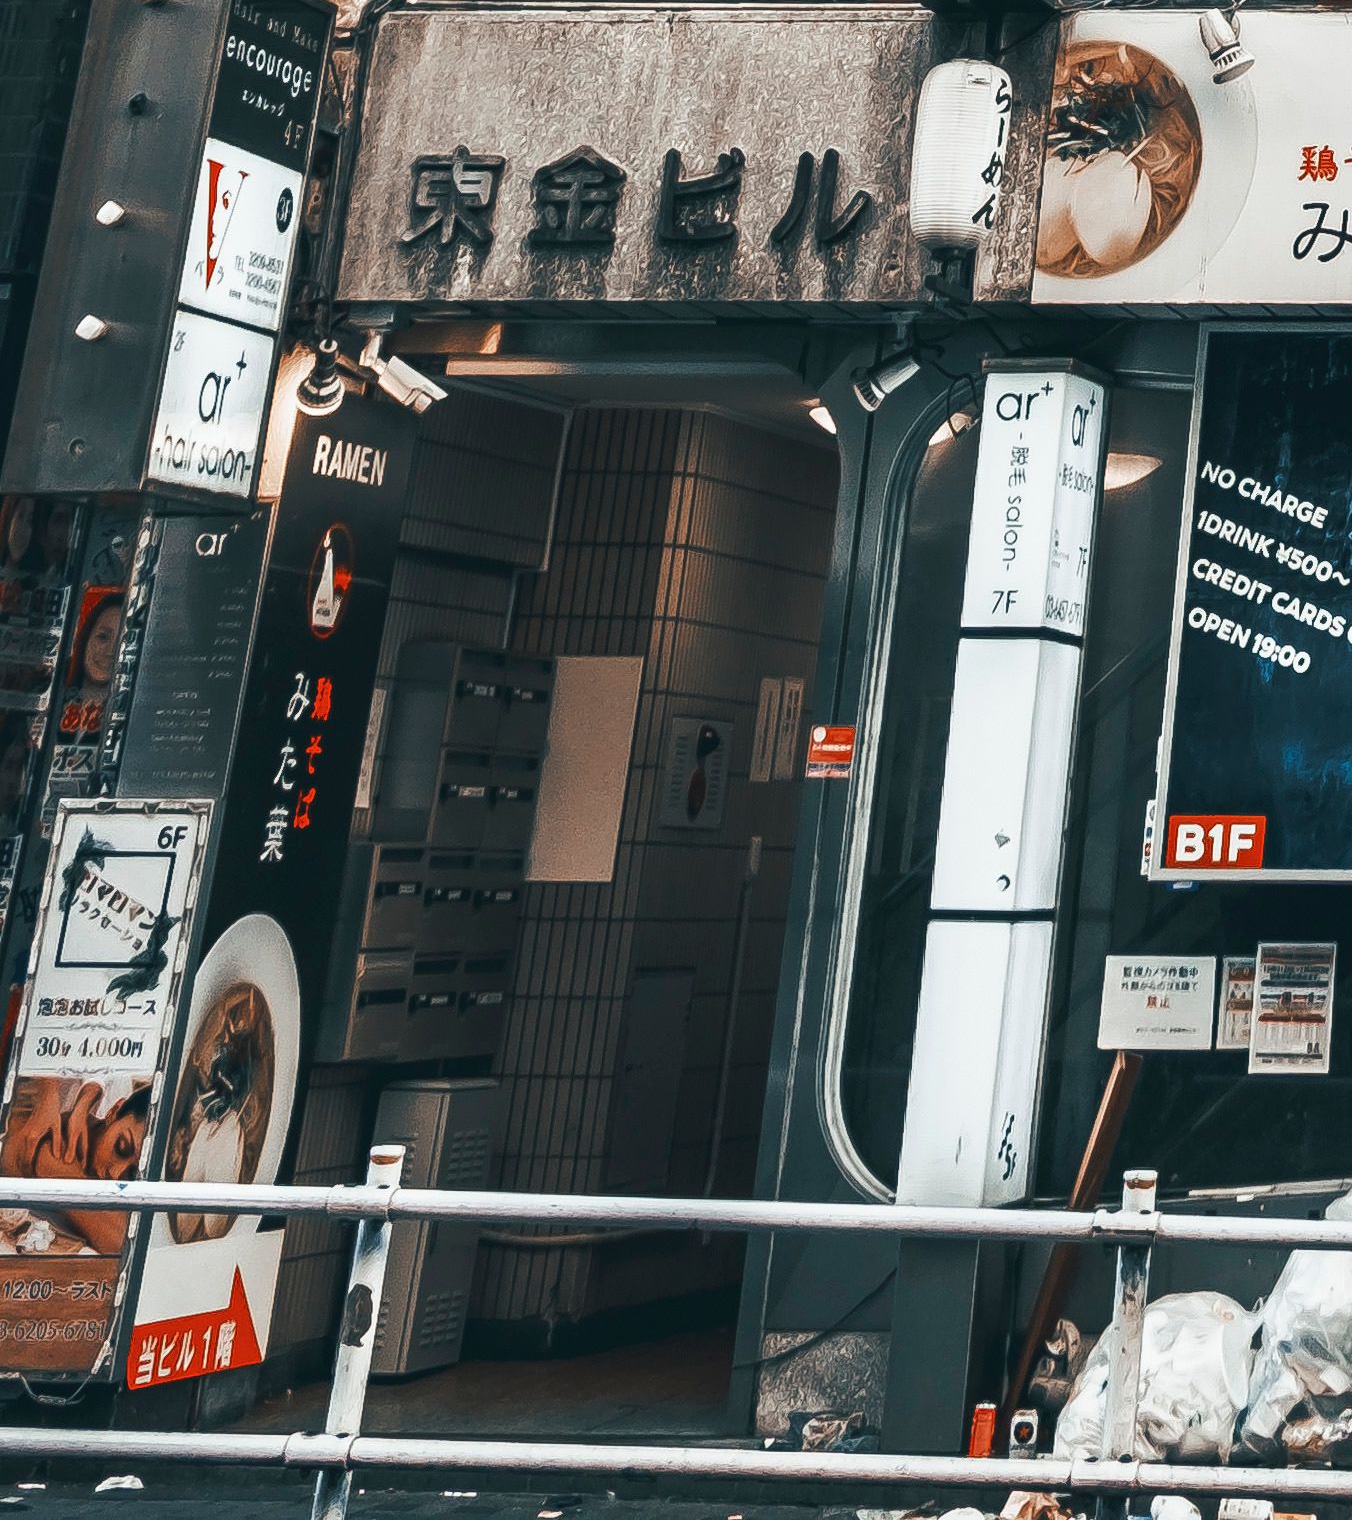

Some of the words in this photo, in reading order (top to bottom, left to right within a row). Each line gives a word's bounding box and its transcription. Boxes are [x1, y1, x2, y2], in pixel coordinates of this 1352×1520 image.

[226, 34, 312, 98] encourage
[970, 78, 1011, 231] らーめん
[403, 145, 874, 245] 東金ビル
[312, 435, 388, 487] RAMEN
[1201, 461, 1236, 489] NO
[1238, 477, 1329, 529] CHARGE
[1197, 510, 1275, 558] 1DRINK
[991, 590, 1019, 615] 7F
[1192, 558, 1273, 604] CREDIT
[1271, 592, 1347, 638] CARDS
[1188, 606, 1251, 649] OPEN
[1252, 633, 1311, 674] 19:00
[259, 671, 310, 862] みた葉
[157, 825, 188, 849] 6F
[1174, 823, 1257, 865] B1F
